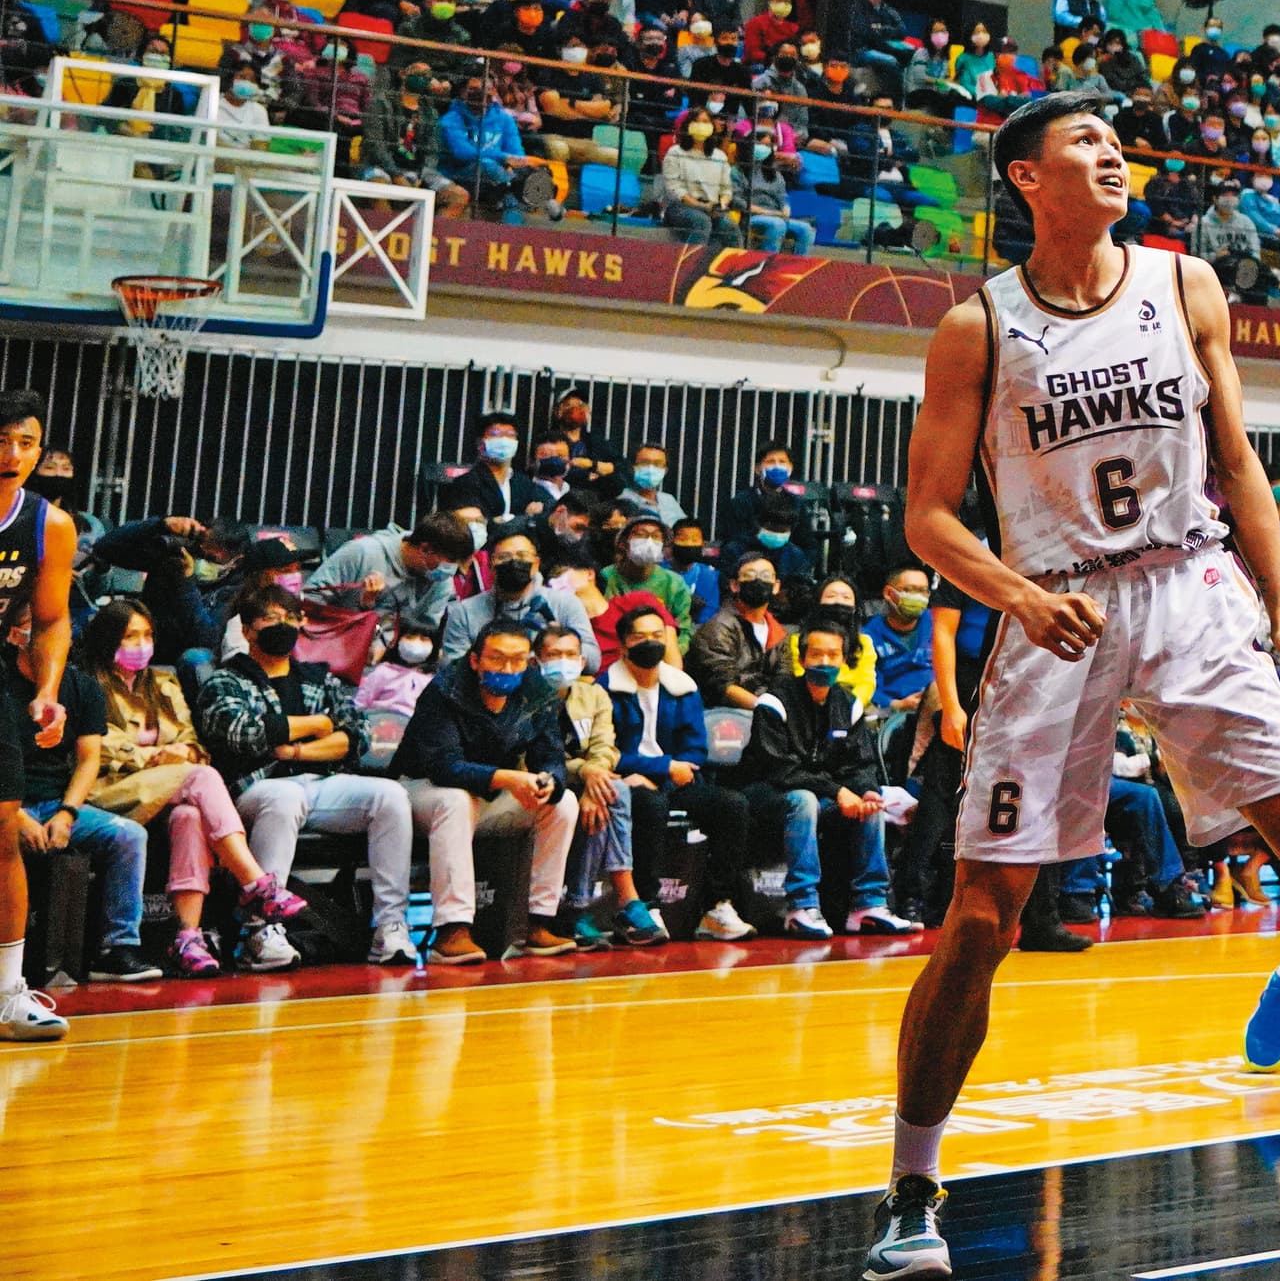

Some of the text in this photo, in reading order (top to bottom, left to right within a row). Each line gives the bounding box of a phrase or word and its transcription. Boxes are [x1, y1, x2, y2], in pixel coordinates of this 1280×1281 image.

[487, 240, 624, 283] HAWKS
[1046, 357, 1148, 398] GHOST
[1020, 376, 1186, 451] HAWKS
[1092, 455, 1144, 530] 6
[988, 779, 1023, 837] 6
